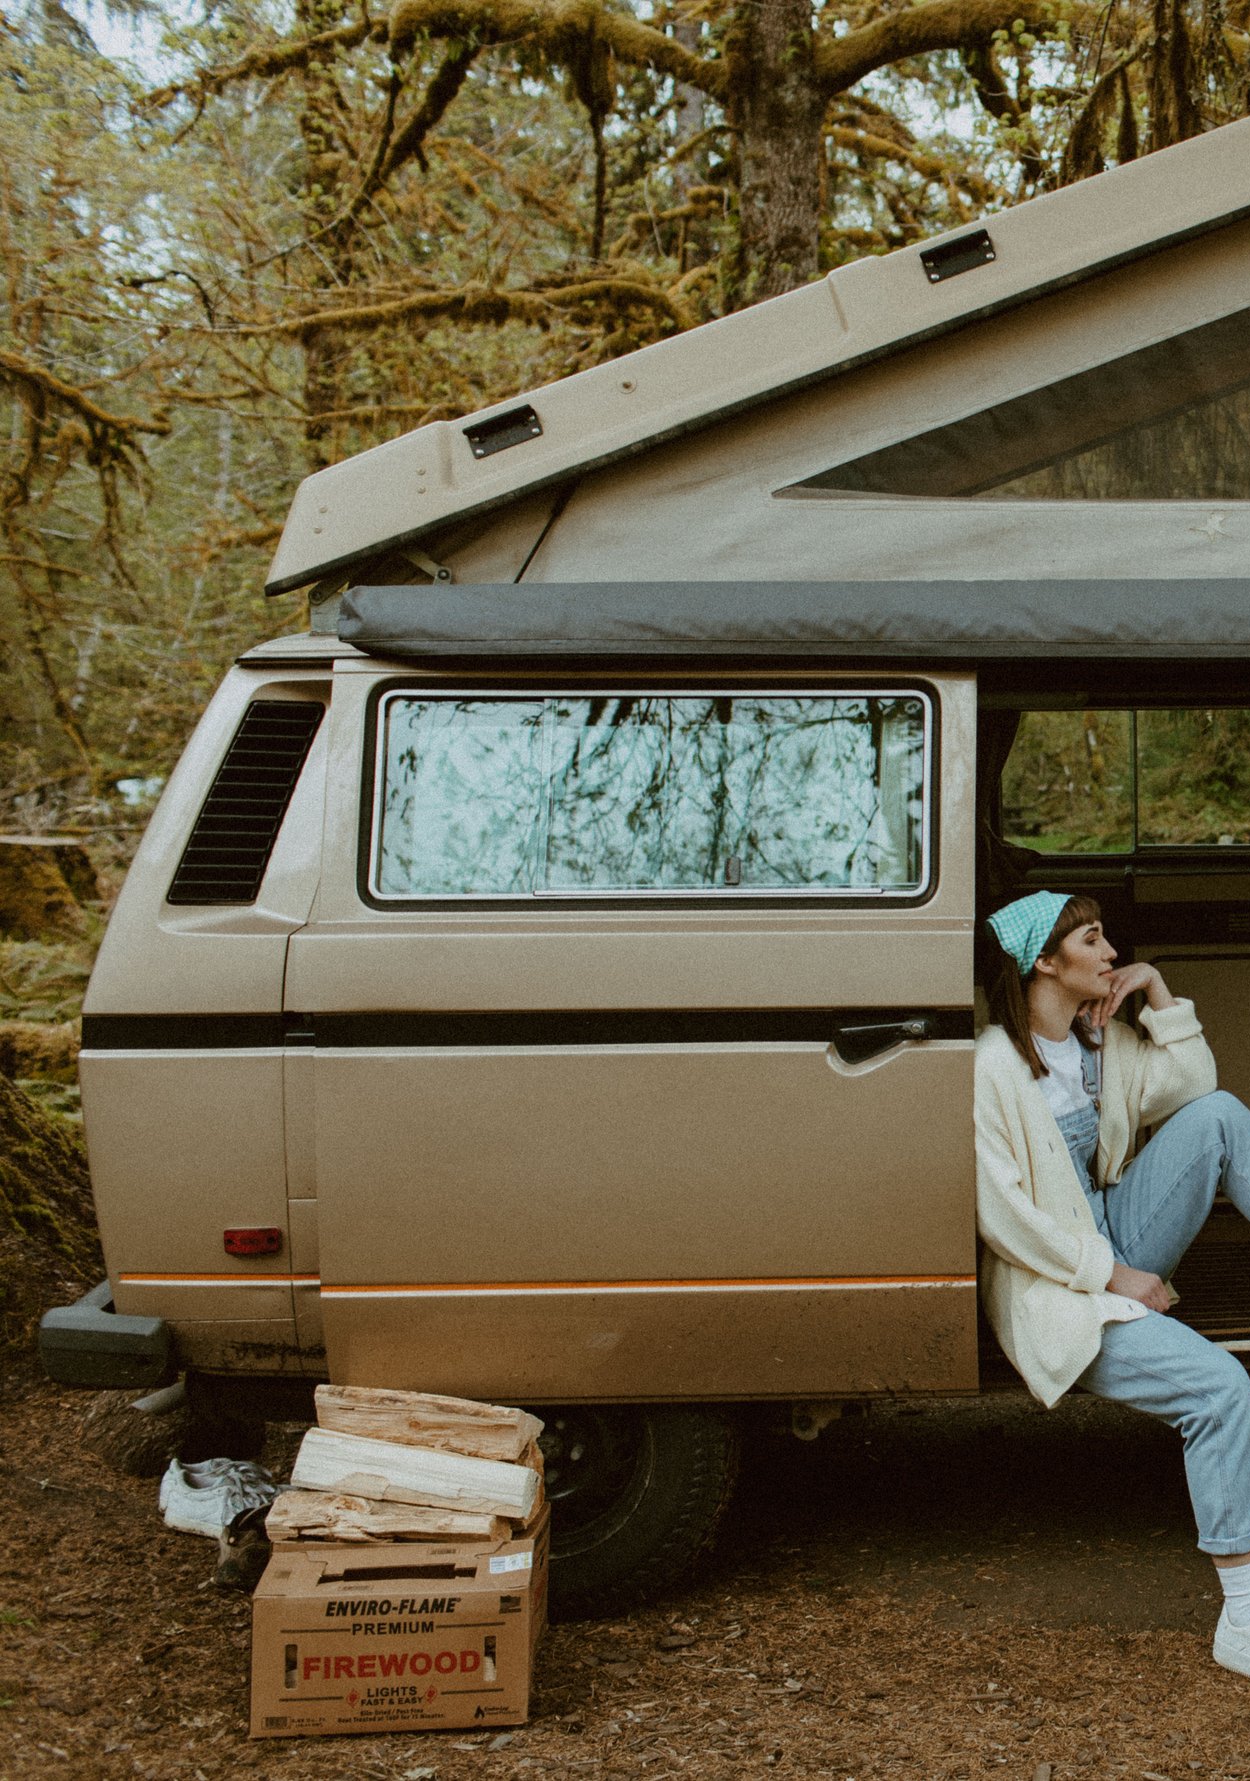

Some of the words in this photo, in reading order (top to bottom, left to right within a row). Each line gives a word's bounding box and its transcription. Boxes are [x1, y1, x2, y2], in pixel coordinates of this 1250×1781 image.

[325, 1597, 459, 1617] ENVIRO-FLAME
[352, 1621, 434, 1635] PREMIUM
[303, 1650, 481, 1681] FIREWOOD
[367, 1686, 417, 1698] LIGHTS
[361, 1698, 385, 1706] FAST
[398, 1696, 424, 1705] EASY
